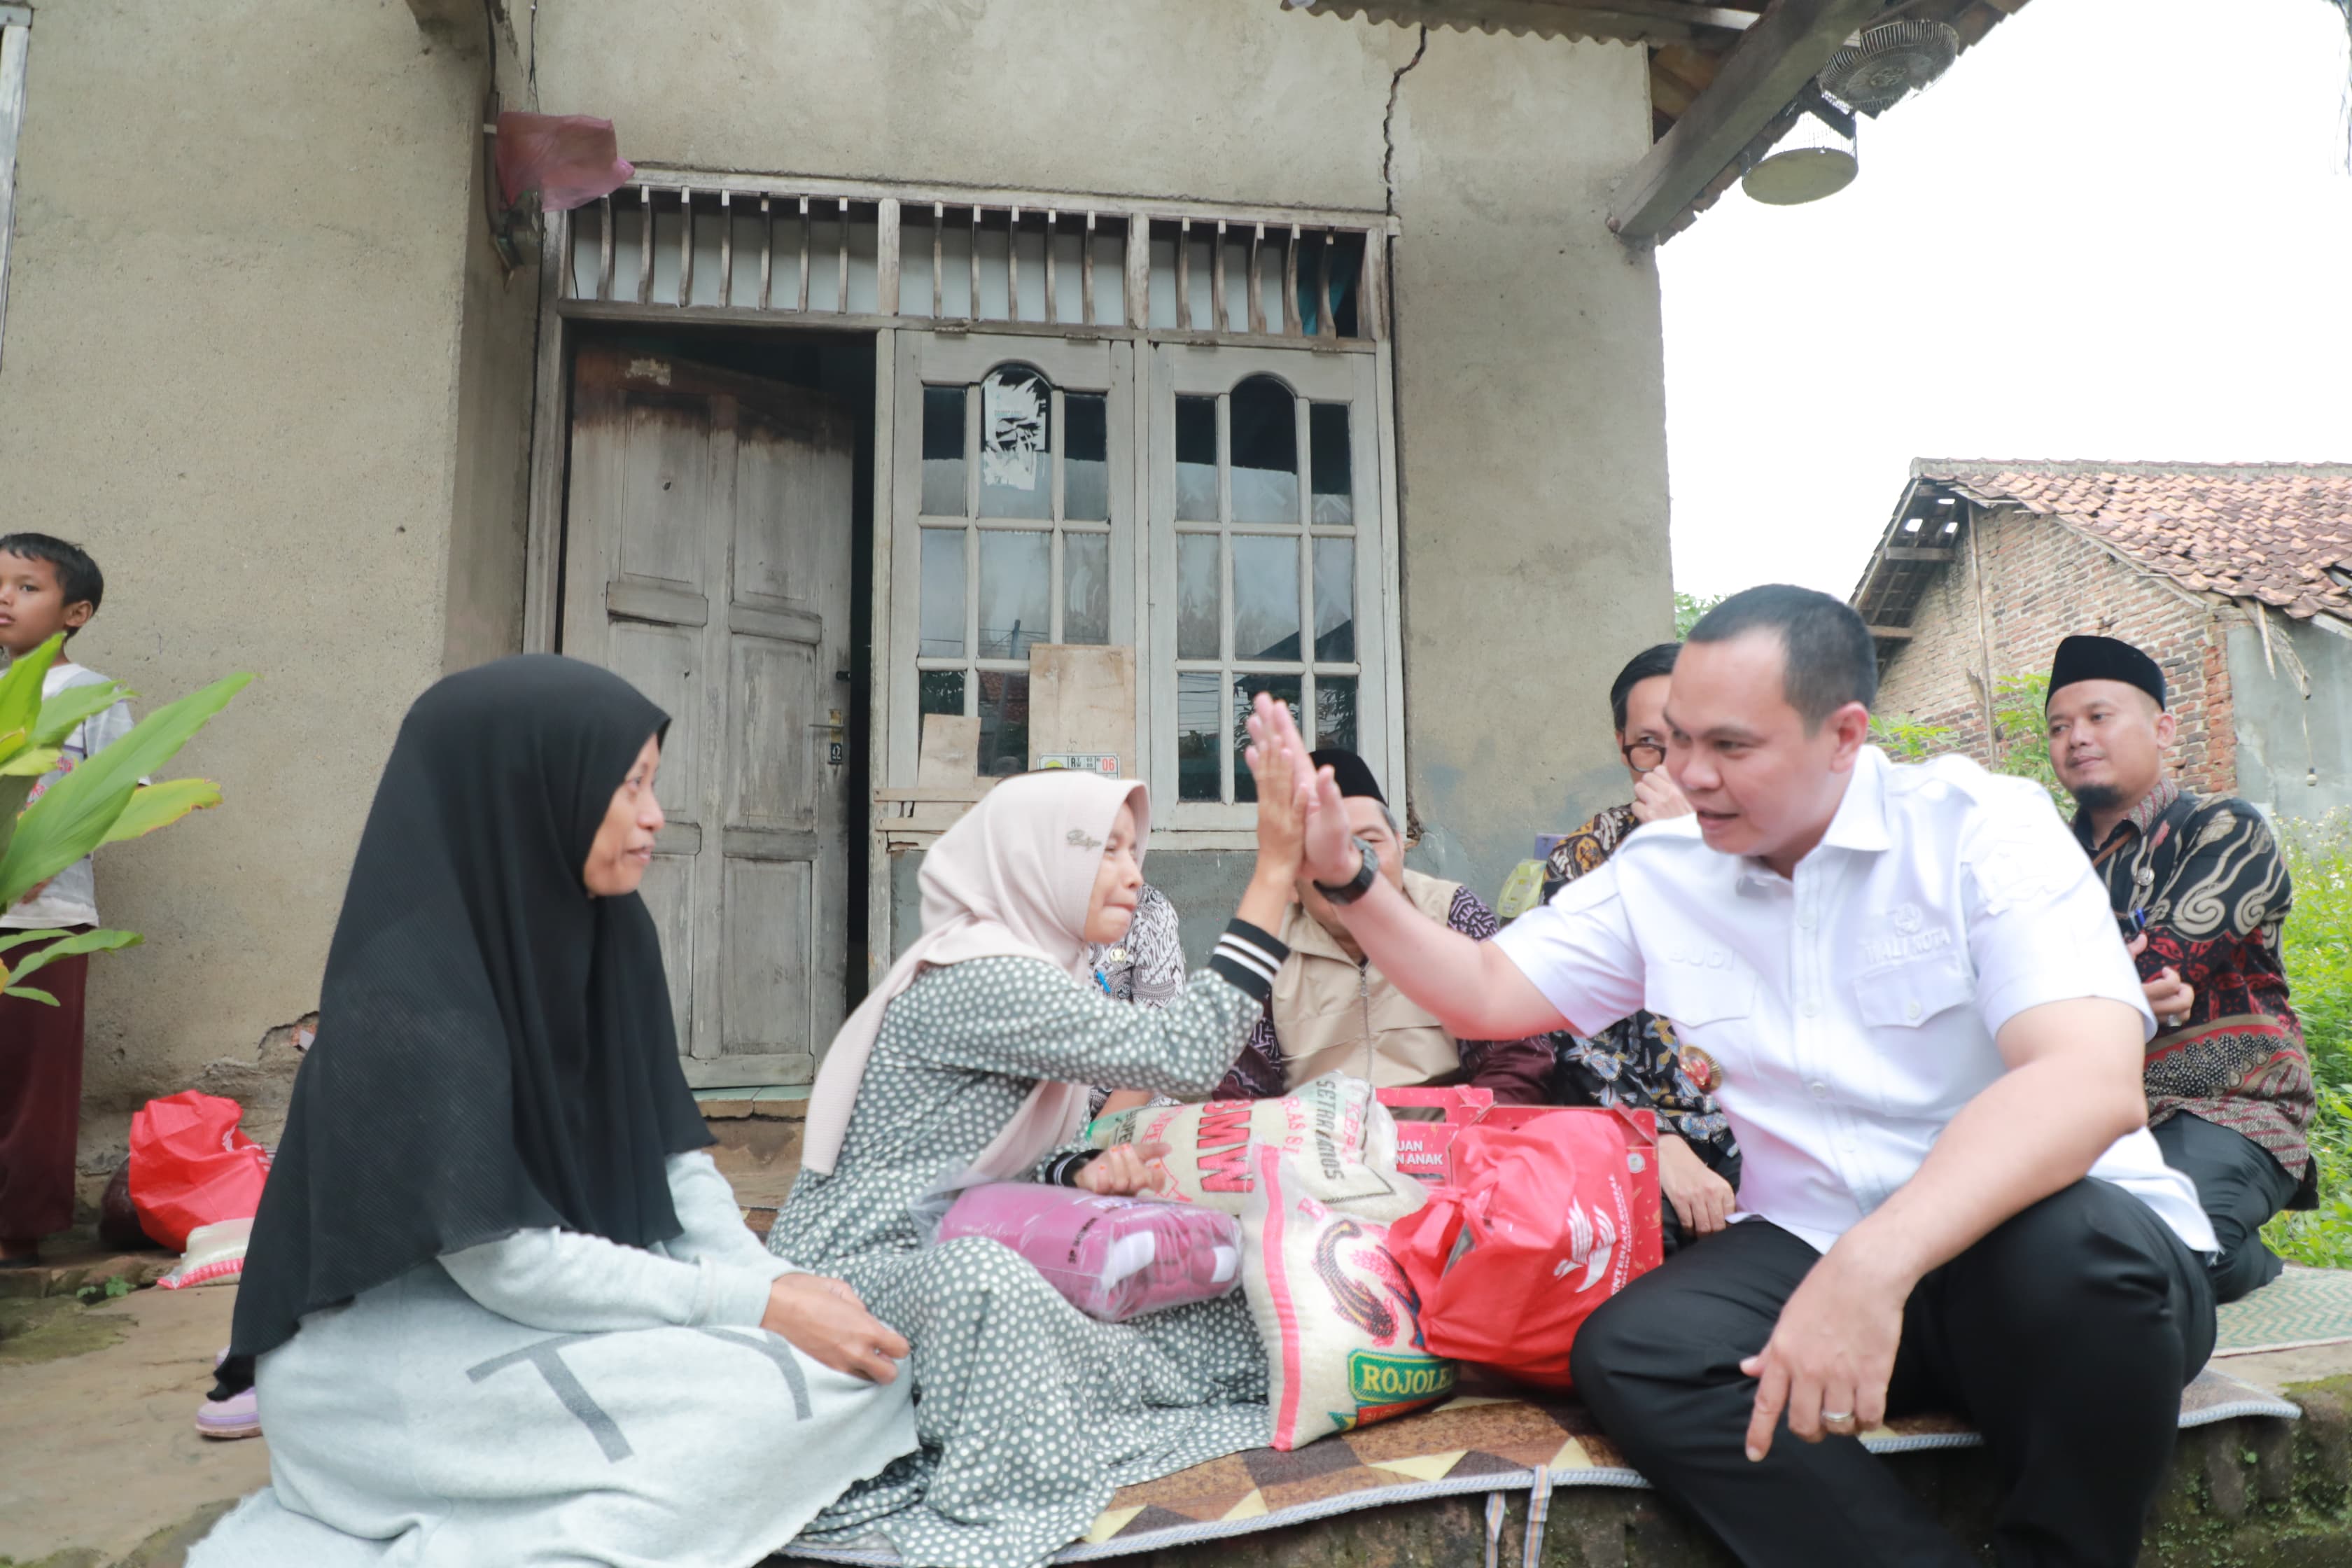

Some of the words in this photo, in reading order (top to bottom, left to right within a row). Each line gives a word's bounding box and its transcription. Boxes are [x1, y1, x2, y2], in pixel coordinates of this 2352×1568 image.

[1102, 757, 1115, 771] 06
[1315, 1130, 1345, 1180] AMOS
[1406, 1153, 1443, 1166] ANAK
[1361, 1364, 1452, 1395] ROJOLE
